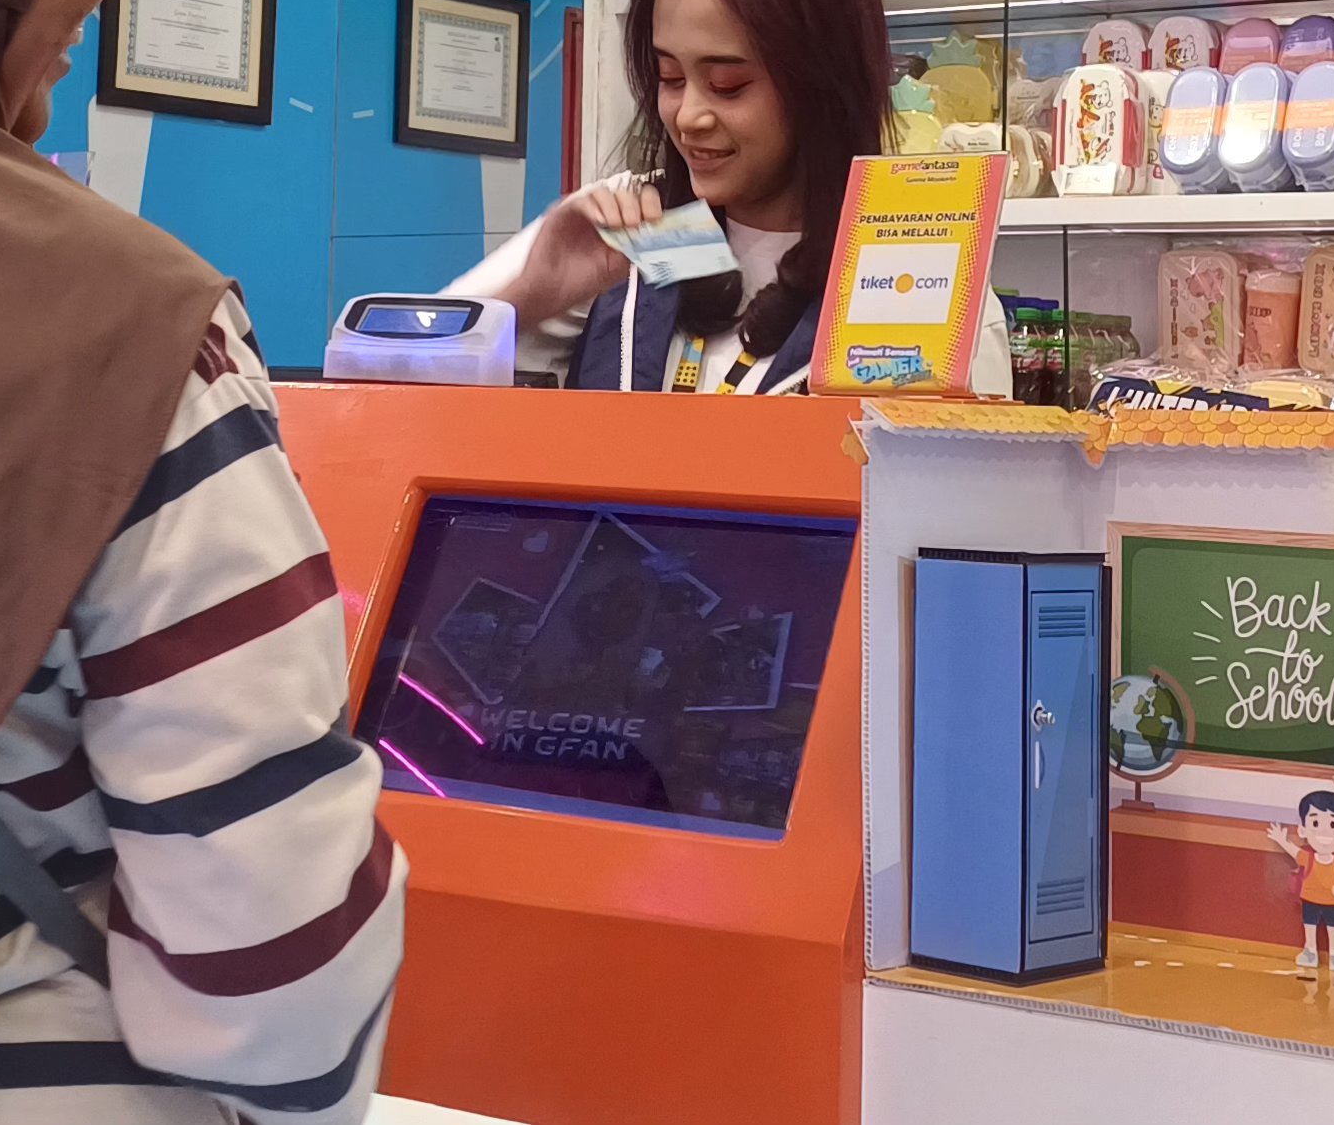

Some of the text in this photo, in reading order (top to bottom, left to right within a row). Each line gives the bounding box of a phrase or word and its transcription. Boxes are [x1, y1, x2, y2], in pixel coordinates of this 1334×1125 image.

[859, 211, 976, 224] PEMBAYARAN ONLINE
[876, 227, 948, 238] BISA MELALUI
[1226, 576, 1332, 637] Back
[1244, 630, 1323, 685] to
[480, 707, 646, 738] WELCOME
[491, 734, 629, 760] IN GFAN
